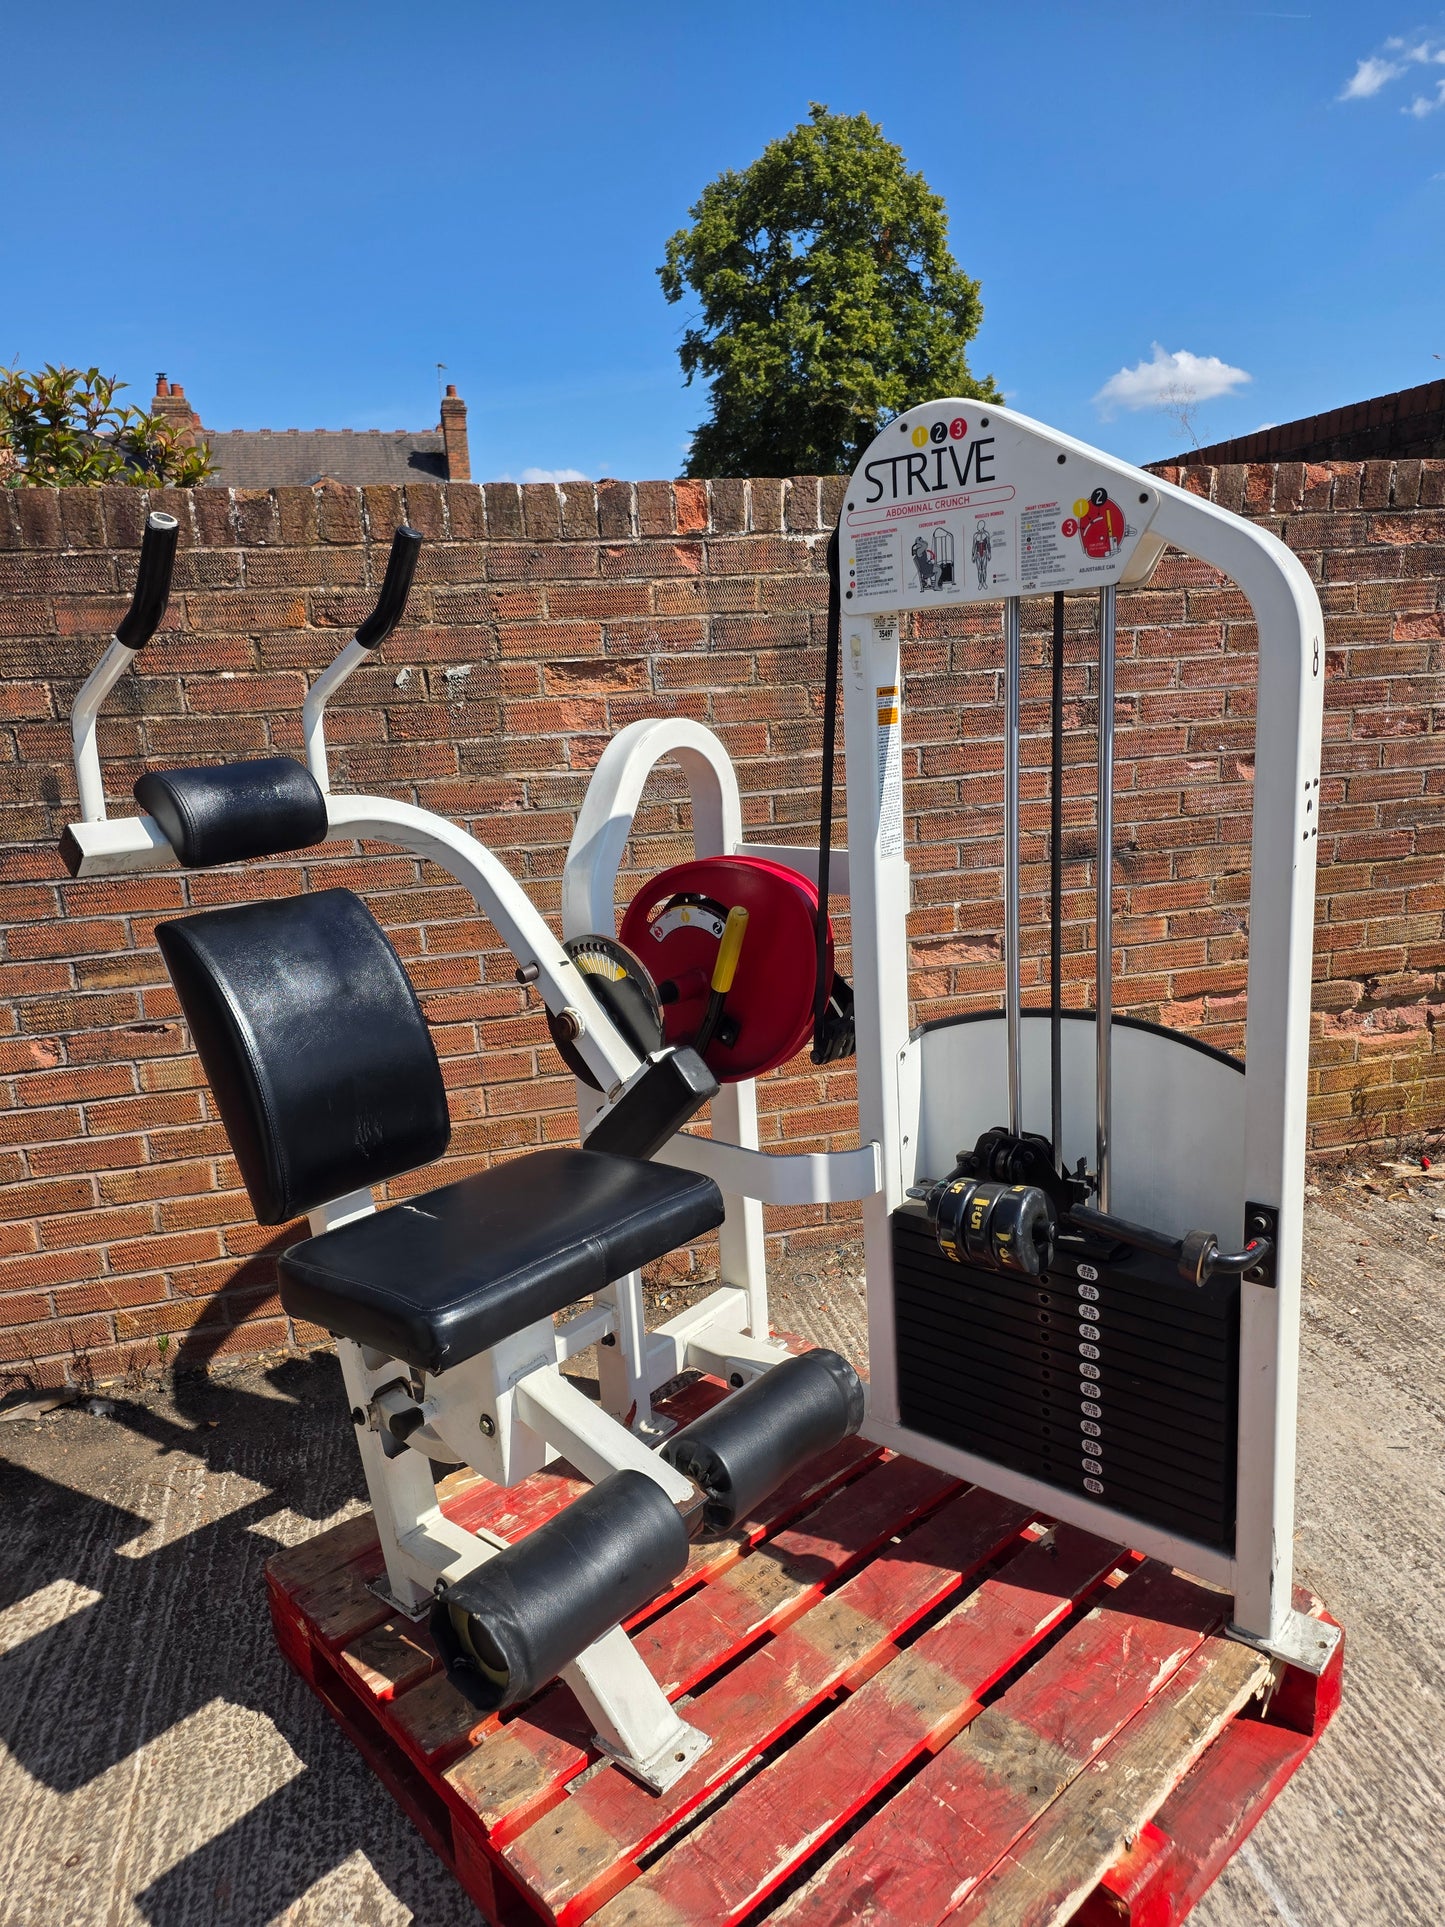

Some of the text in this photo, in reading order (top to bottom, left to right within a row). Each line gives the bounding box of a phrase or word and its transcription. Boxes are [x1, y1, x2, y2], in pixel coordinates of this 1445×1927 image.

[864, 437, 996, 503] STRIVE
[886, 495, 970, 518] ABDOMINAL CRUNCH
[1079, 564, 1105, 573] ADJUSTABLE
